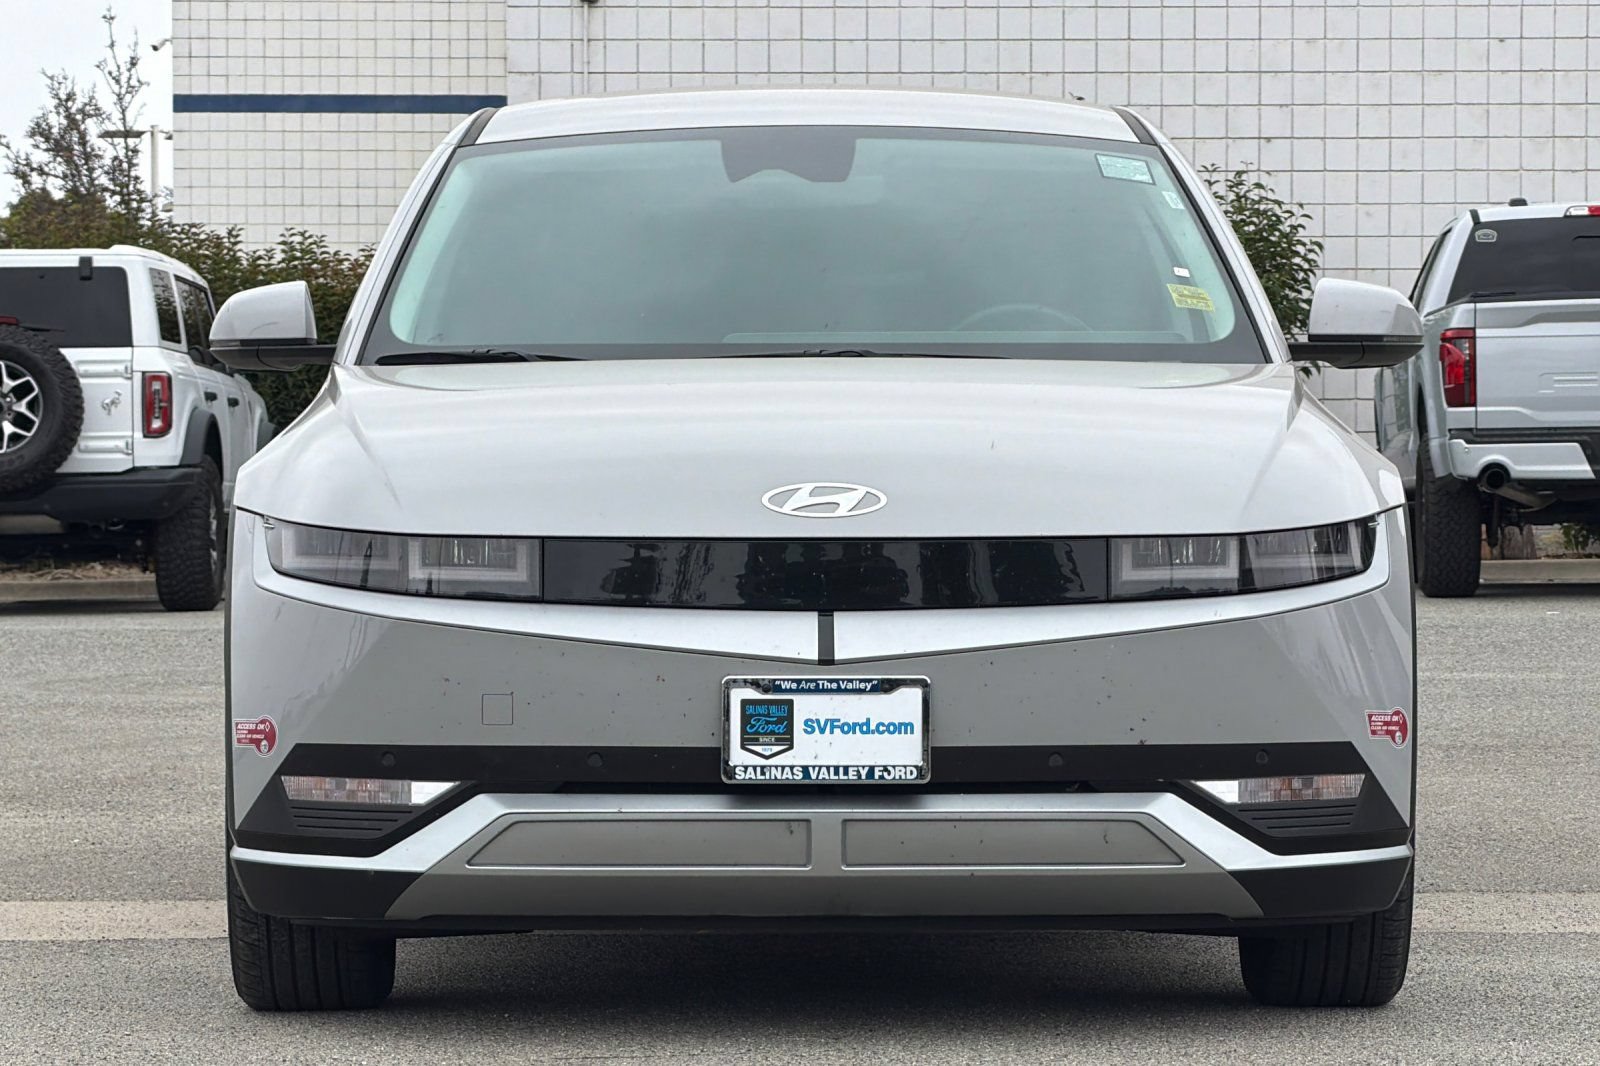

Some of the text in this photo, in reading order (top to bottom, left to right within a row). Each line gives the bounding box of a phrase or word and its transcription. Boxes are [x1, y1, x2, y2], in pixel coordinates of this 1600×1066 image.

[799, 680, 816, 690] Are
[817, 680, 838, 690] The
[745, 704, 788, 716] SALINAS VALLEY
[746, 716, 788, 732] Ford
[803, 718, 914, 734] SVFord.com
[734, 766, 918, 780] SALINAS VALLEY FORD
